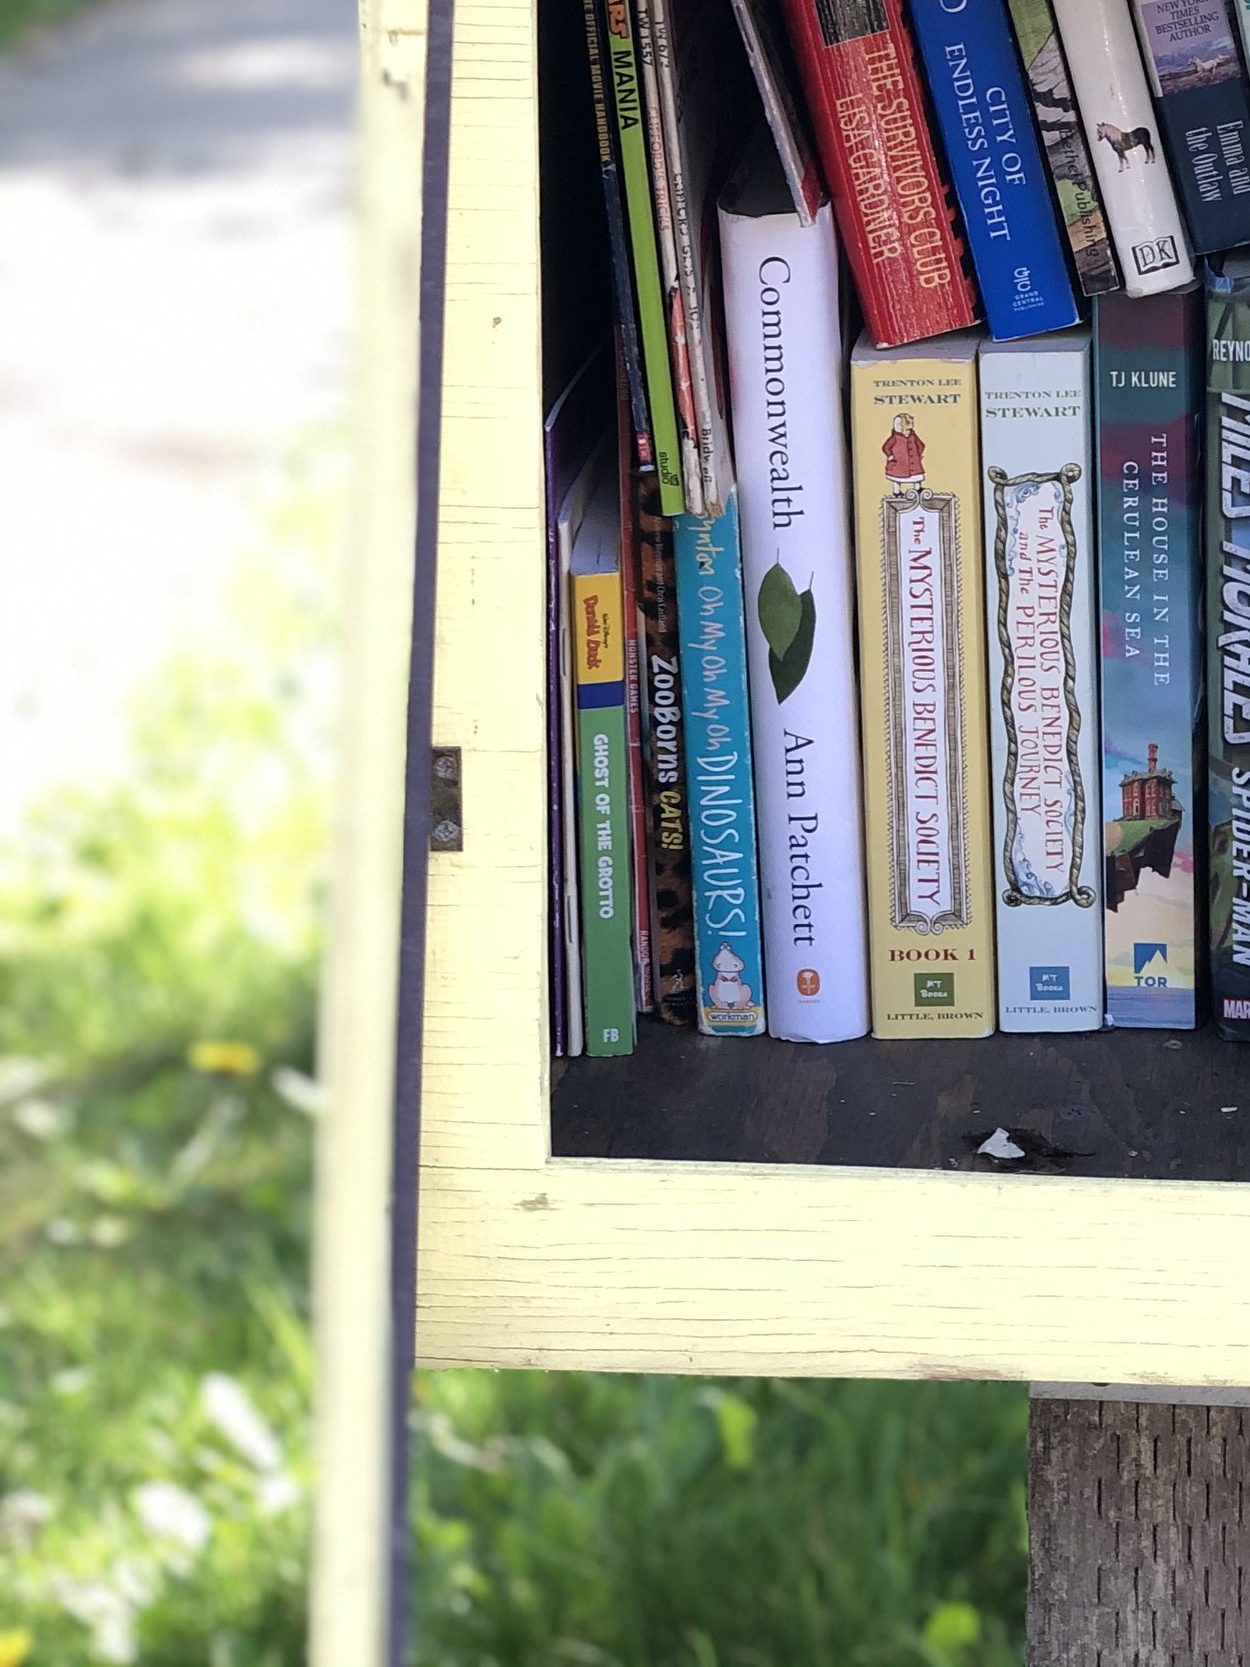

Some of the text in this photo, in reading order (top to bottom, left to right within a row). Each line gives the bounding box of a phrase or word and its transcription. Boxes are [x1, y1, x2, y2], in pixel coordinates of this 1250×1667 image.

[1155, 12, 1219, 35] BESTSELLING
[1169, 24, 1212, 43] AUTHOR
[584, 13, 612, 163] OFFICIAL HANDBOOK
[613, 49, 640, 130] MANIA
[865, 40, 951, 288] THE SURVIVORS CLUB
[945, 42, 1011, 241] ENDLESS NIGHT
[986, 86, 1026, 186] CITY OF
[1217, 120, 1246, 167] Emma
[835, 93, 902, 263] LISA GARDNER
[1192, 153, 1224, 203] Outlaw
[1073, 178, 1100, 258] Publishing
[1139, 240, 1171, 269] DK
[758, 256, 806, 531] Commonwealth
[873, 377, 962, 388] TRENTON LEE
[873, 393, 961, 406] STEWART
[985, 389, 1082, 400] TRENTON LEE
[985, 405, 1081, 419] STEWART
[1110, 371, 1177, 387] TJ KLUNE
[659, 451, 672, 485] studio
[1122, 461, 1141, 659] CERULEAN SEA
[1151, 433, 1171, 687] THE HOUSE IN THE
[1015, 531, 1042, 816] and The PERILOUS JOURNEY
[1036, 507, 1065, 874] The MYSTERIOUS BENEDICT SOCIETY
[908, 516, 941, 908] The MYSTERIOUS BENEDICT SOCIETY
[688, 586, 748, 937] Oh My Oh My Oh DINOSAURS!
[593, 733, 615, 919] GHOST OF THE GROTTO
[659, 790, 684, 851] CATS!
[783, 729, 824, 947] Ann Patchett
[889, 948, 977, 963] BOOK 1
[1134, 975, 1168, 988] TOR
[887, 1011, 984, 1022] LITTLE, BROWN
[1006, 1004, 1098, 1015] LITTLE, BROWN
